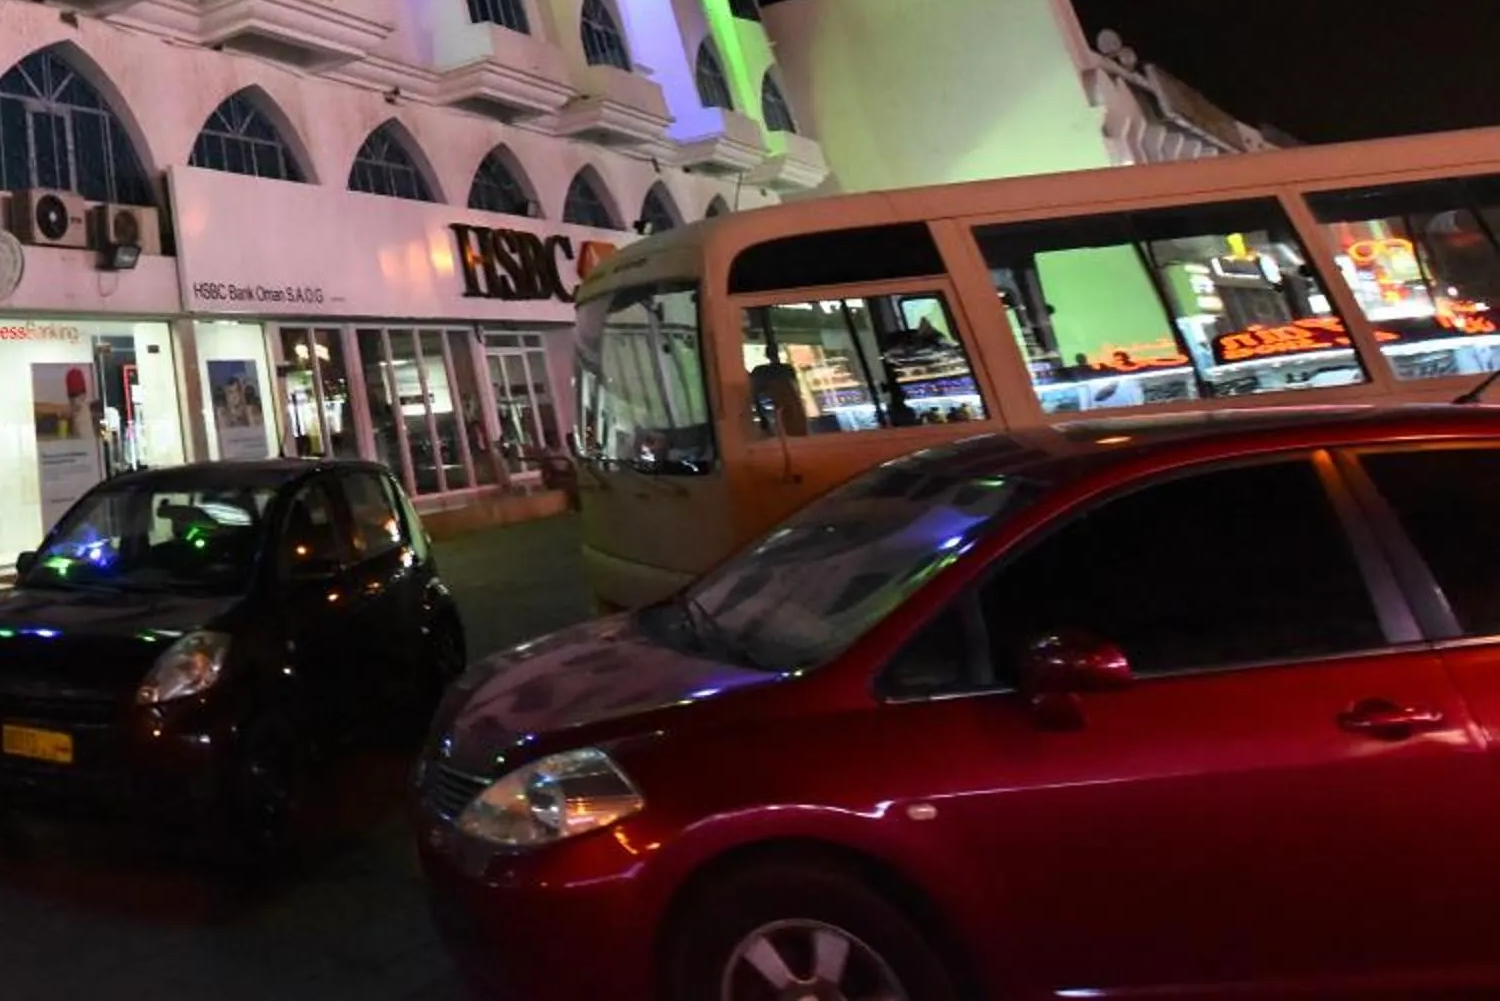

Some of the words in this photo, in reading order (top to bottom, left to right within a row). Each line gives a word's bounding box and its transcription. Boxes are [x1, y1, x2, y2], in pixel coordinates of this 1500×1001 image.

[449, 223, 576, 303] HSBC
[194, 282, 226, 299] HSBC
[229, 284, 253, 300] Bank
[255, 284, 284, 301] Oman
